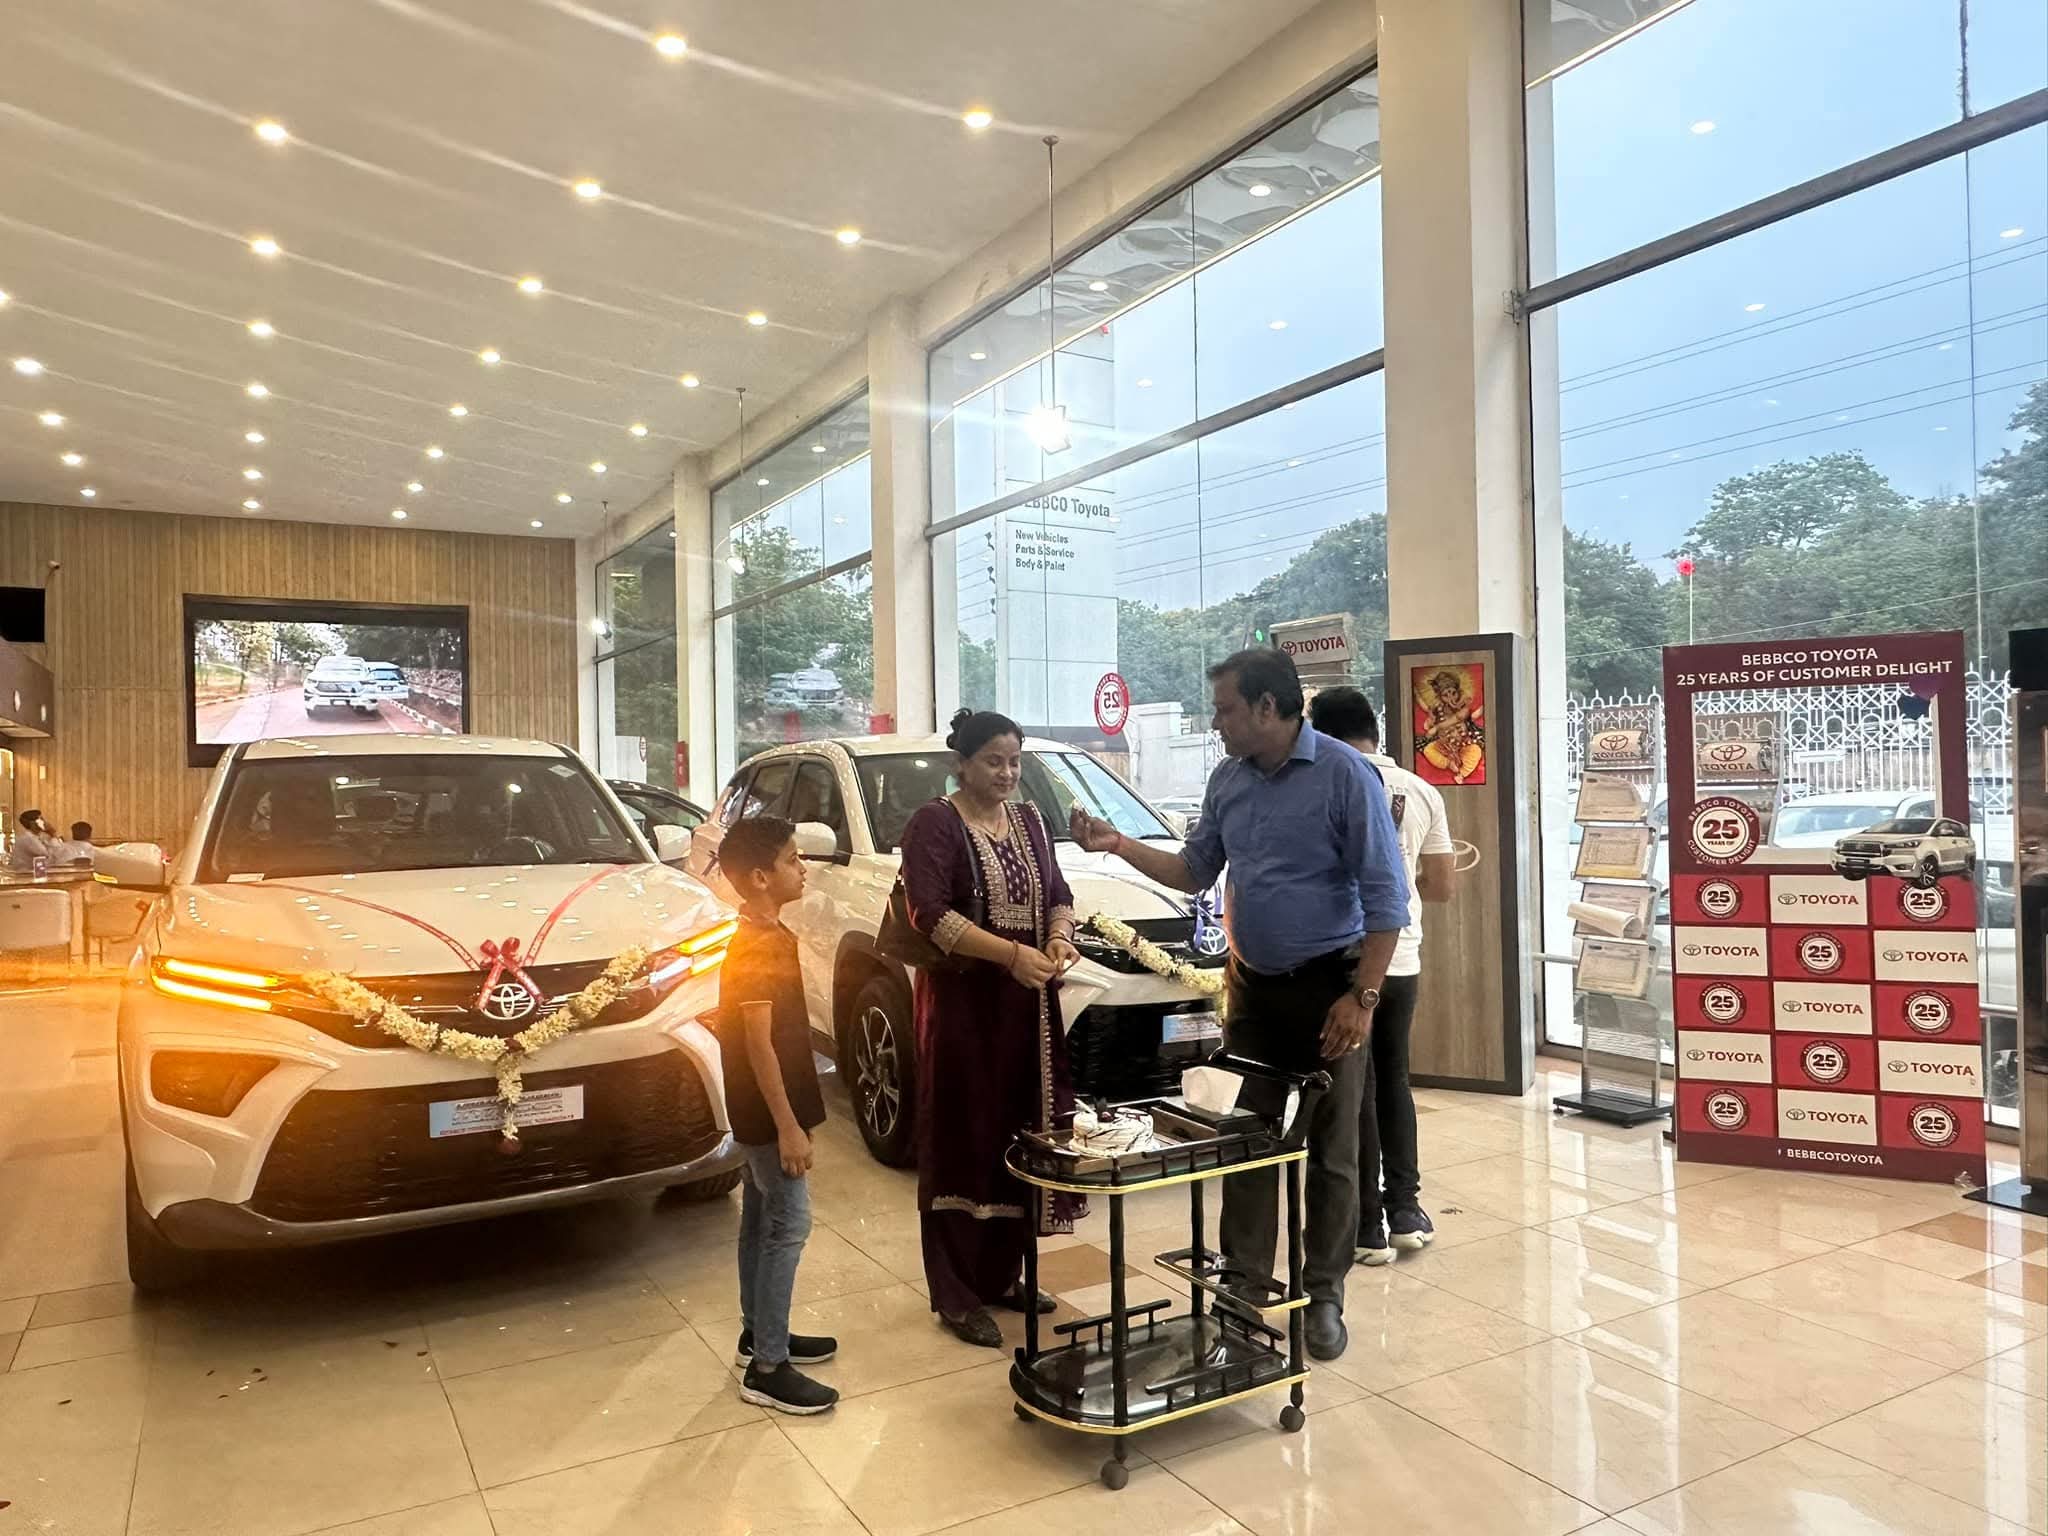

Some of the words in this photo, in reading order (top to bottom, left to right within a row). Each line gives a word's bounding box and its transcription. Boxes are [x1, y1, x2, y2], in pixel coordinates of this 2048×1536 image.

[1024, 495, 1068, 513] BBCO
[1071, 498, 1110, 518] Toyota
[1015, 529, 1034, 541] New
[1035, 531, 1069, 544] Vehicles
[1015, 543, 1036, 555] Parts
[1045, 546, 1075, 558] Service
[1015, 558, 1035, 571] Body
[1036, 560, 1043, 569] &
[1045, 561, 1065, 571] Paint
[1297, 635, 1345, 653] TOYOTA
[1742, 650, 1807, 667] BEBBCO
[1810, 647, 1878, 662] TOYOTA
[1676, 673, 1696, 686] 25
[1699, 671, 1750, 684] YEARS
[1754, 670, 1776, 683] OF
[1779, 665, 1872, 681] CUSTOMER
[1877, 660, 1953, 677] DELIGHT
[1703, 762, 1755, 772] TOYOTA
[1724, 799, 1755, 822] TOYOTA
[1702, 818, 1740, 840] 25
[1707, 890, 1731, 903] 25
[1799, 894, 1859, 905] TOYOTA
[1910, 892, 1936, 906] 25
[1703, 945, 1759, 957] TOYOTA
[1807, 945, 1833, 958] 25
[1906, 951, 1969, 963] TOYOTA
[1711, 995, 1734, 1009] 25
[1803, 1002, 1864, 1015] TOYOTA
[1914, 1004, 1940, 1019] 25
[1707, 1050, 1764, 1064] TOYOTA
[1812, 1054, 1837, 1069] 25
[1910, 1062, 1975, 1077] TOYOTA
[1714, 1101, 1738, 1115] 25
[1807, 1111, 1869, 1125] TOYOTA
[1920, 1116, 1946, 1132] 25
[1786, 1148, 1884, 1165] BEBBCOTOYOTA
